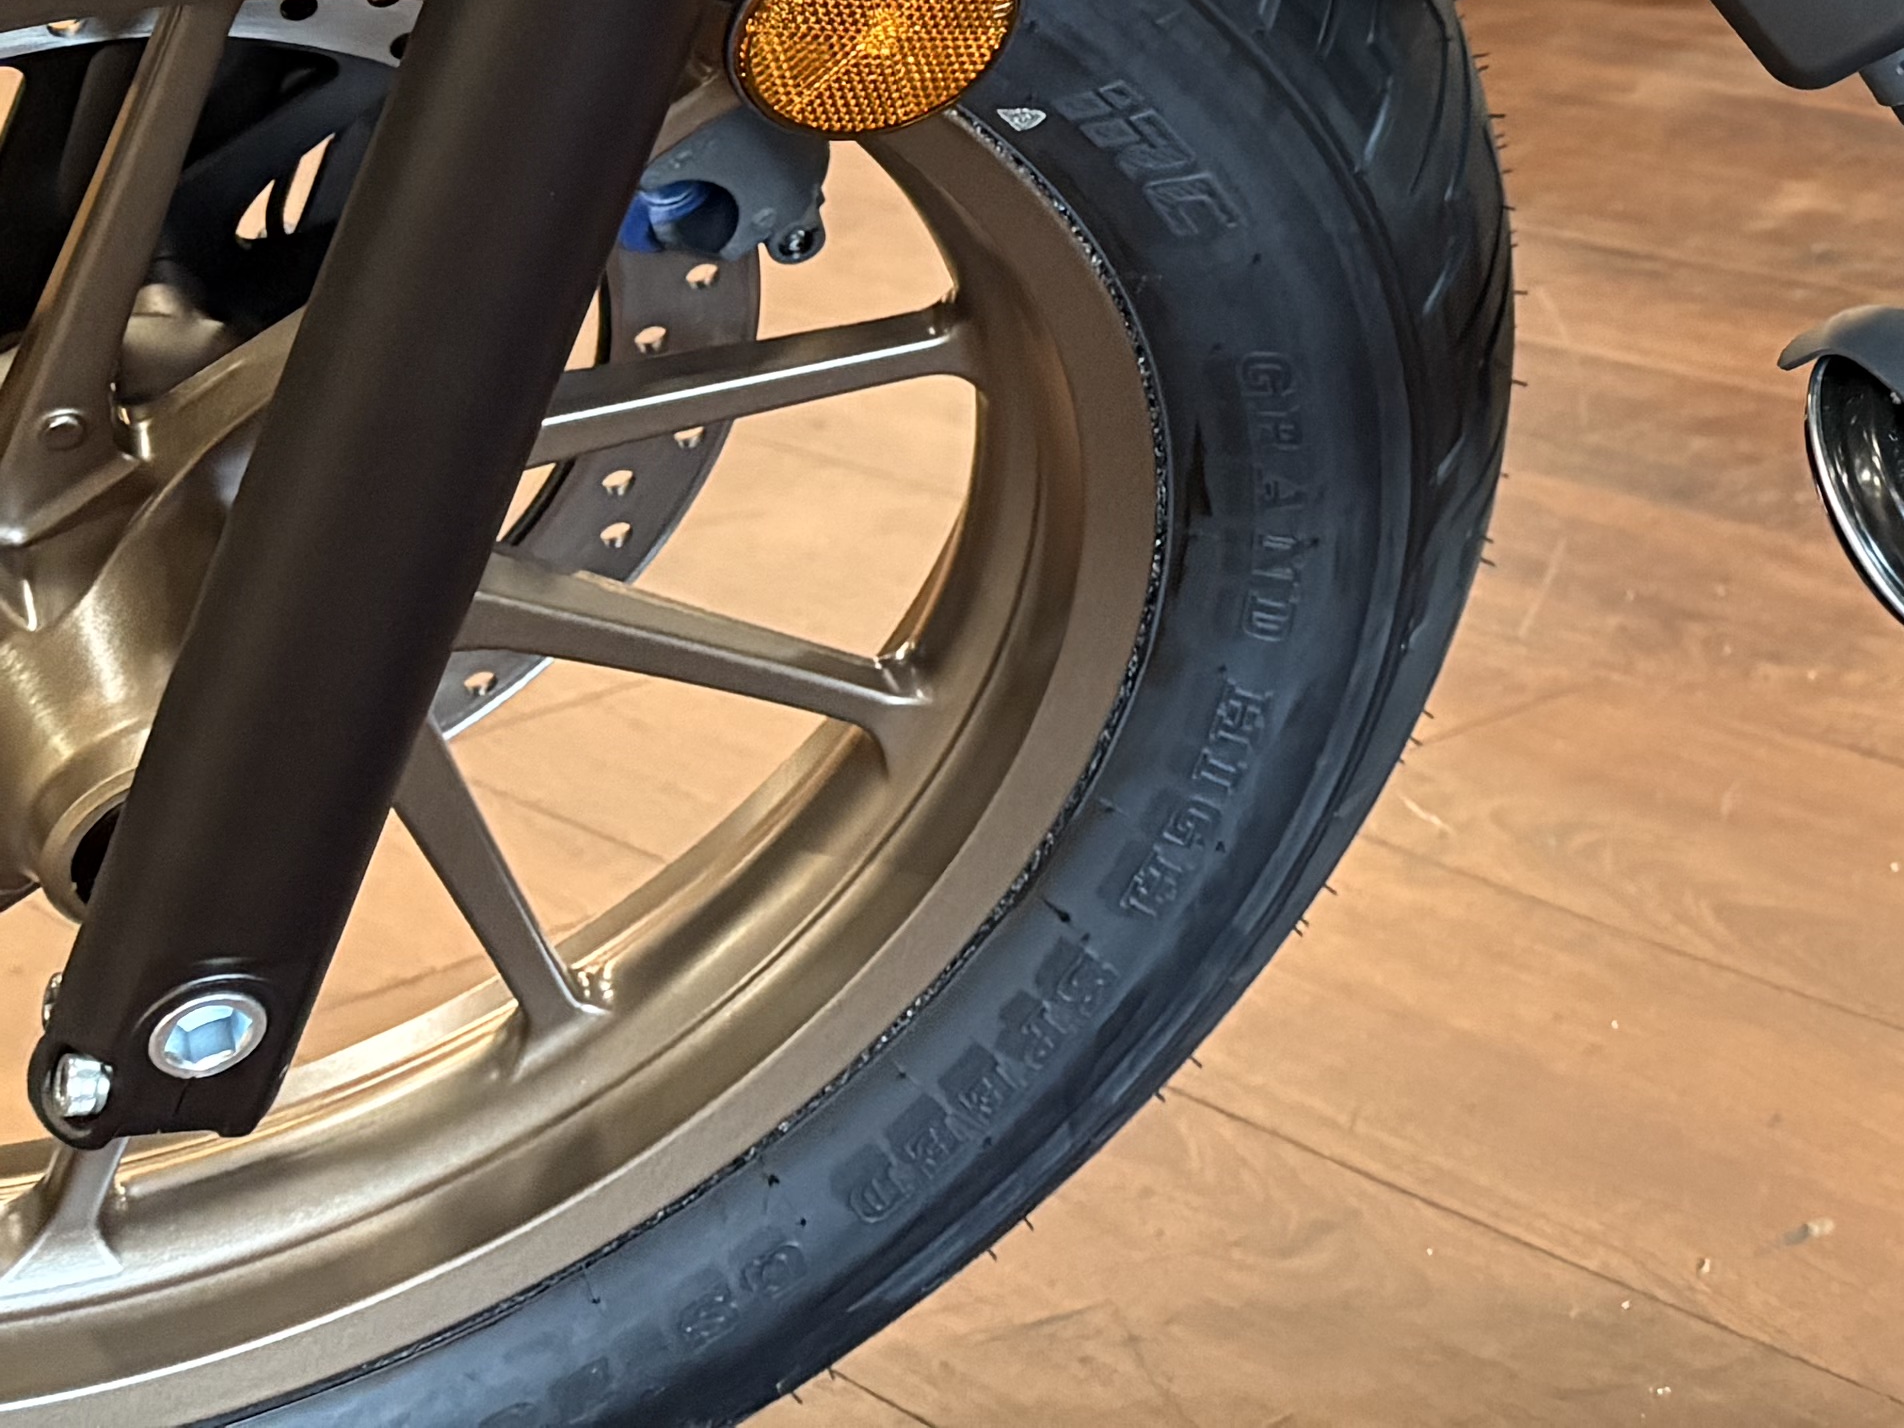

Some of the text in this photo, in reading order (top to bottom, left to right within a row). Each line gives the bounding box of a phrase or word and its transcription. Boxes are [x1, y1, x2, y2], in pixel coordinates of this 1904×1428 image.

[846, 350, 1303, 1223] GRAND HIGH SPEED
